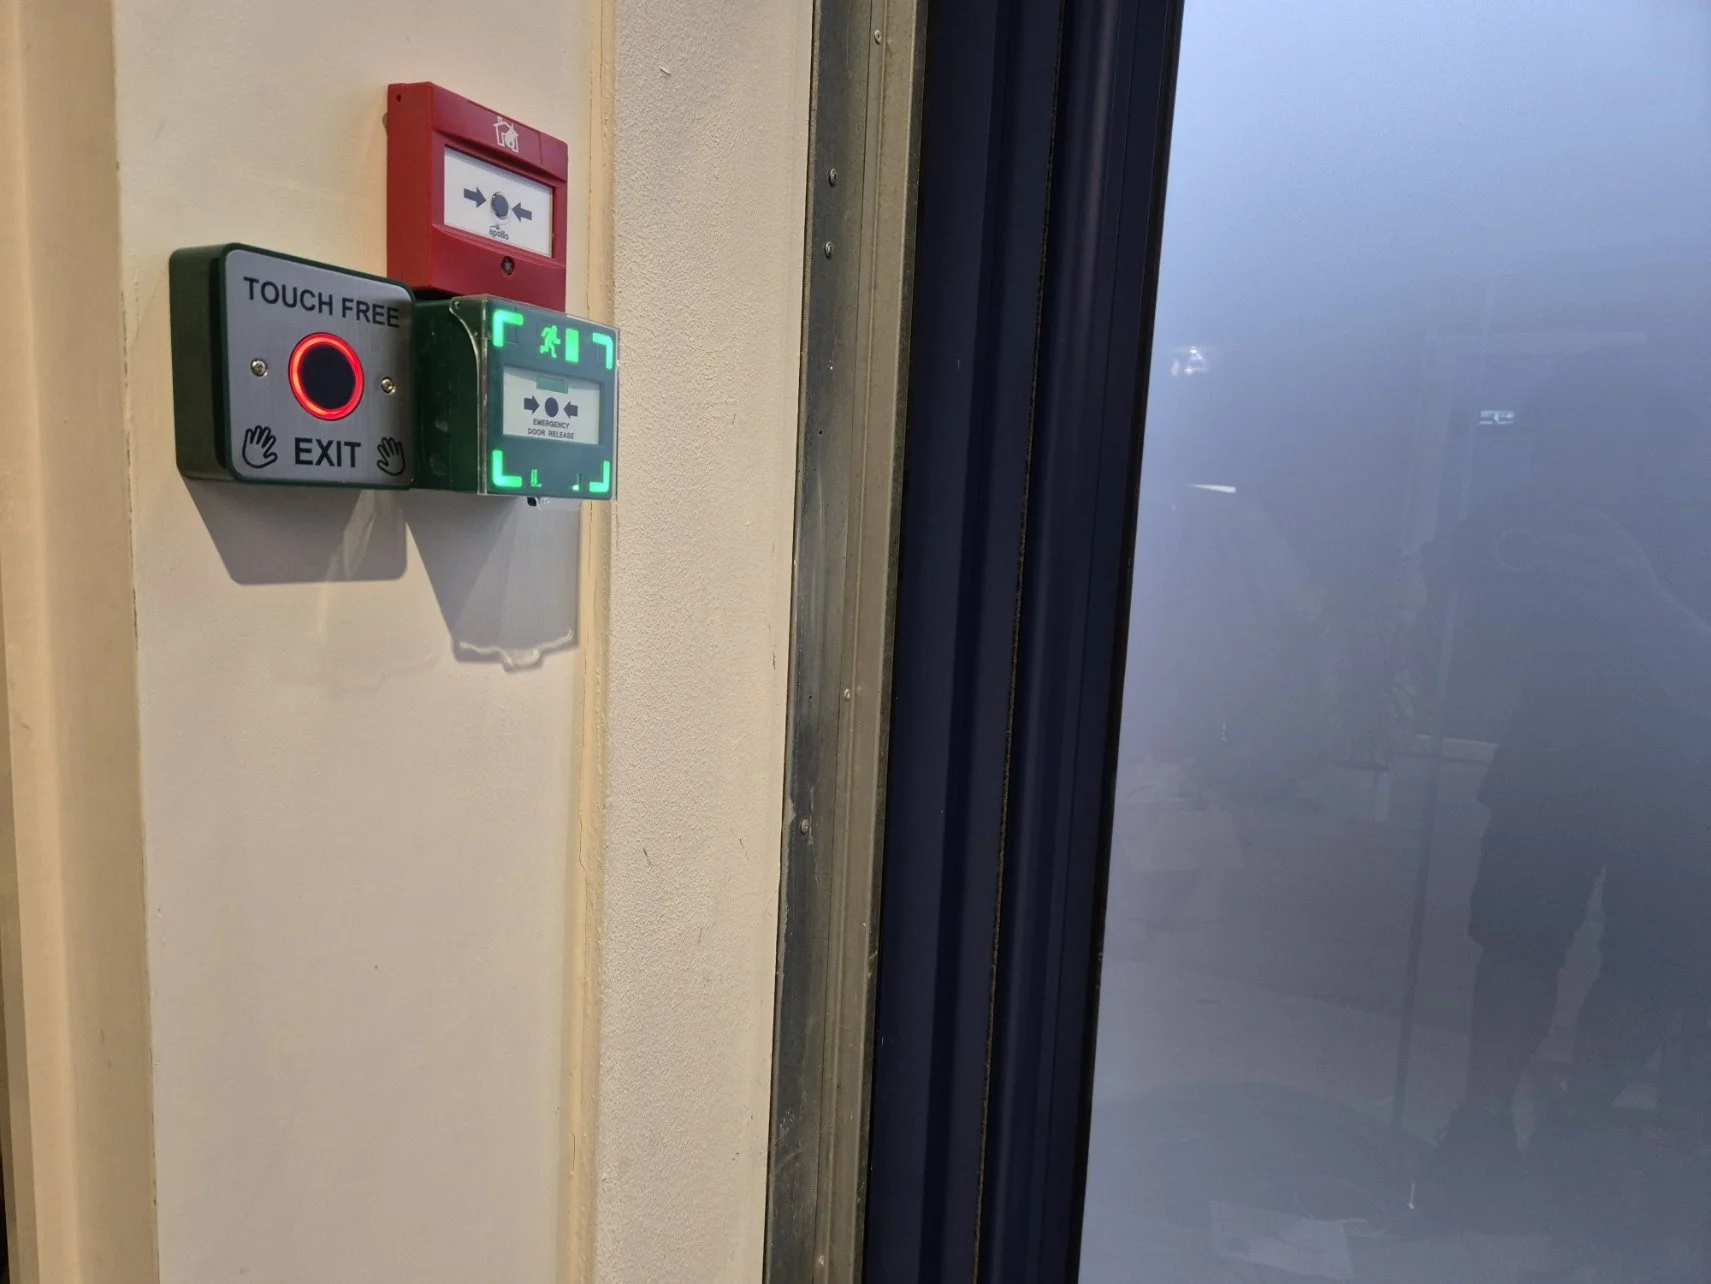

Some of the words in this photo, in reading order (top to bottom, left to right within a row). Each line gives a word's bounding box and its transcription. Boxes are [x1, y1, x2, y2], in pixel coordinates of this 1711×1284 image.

[488, 228, 509, 241] apollo
[243, 276, 333, 316] TOUCH
[342, 297, 400, 328] FREE
[532, 418, 570, 430] EMERGENCY
[527, 428, 546, 437] DOOR
[548, 430, 575, 440] RELEASE
[294, 437, 361, 468] EXIT
